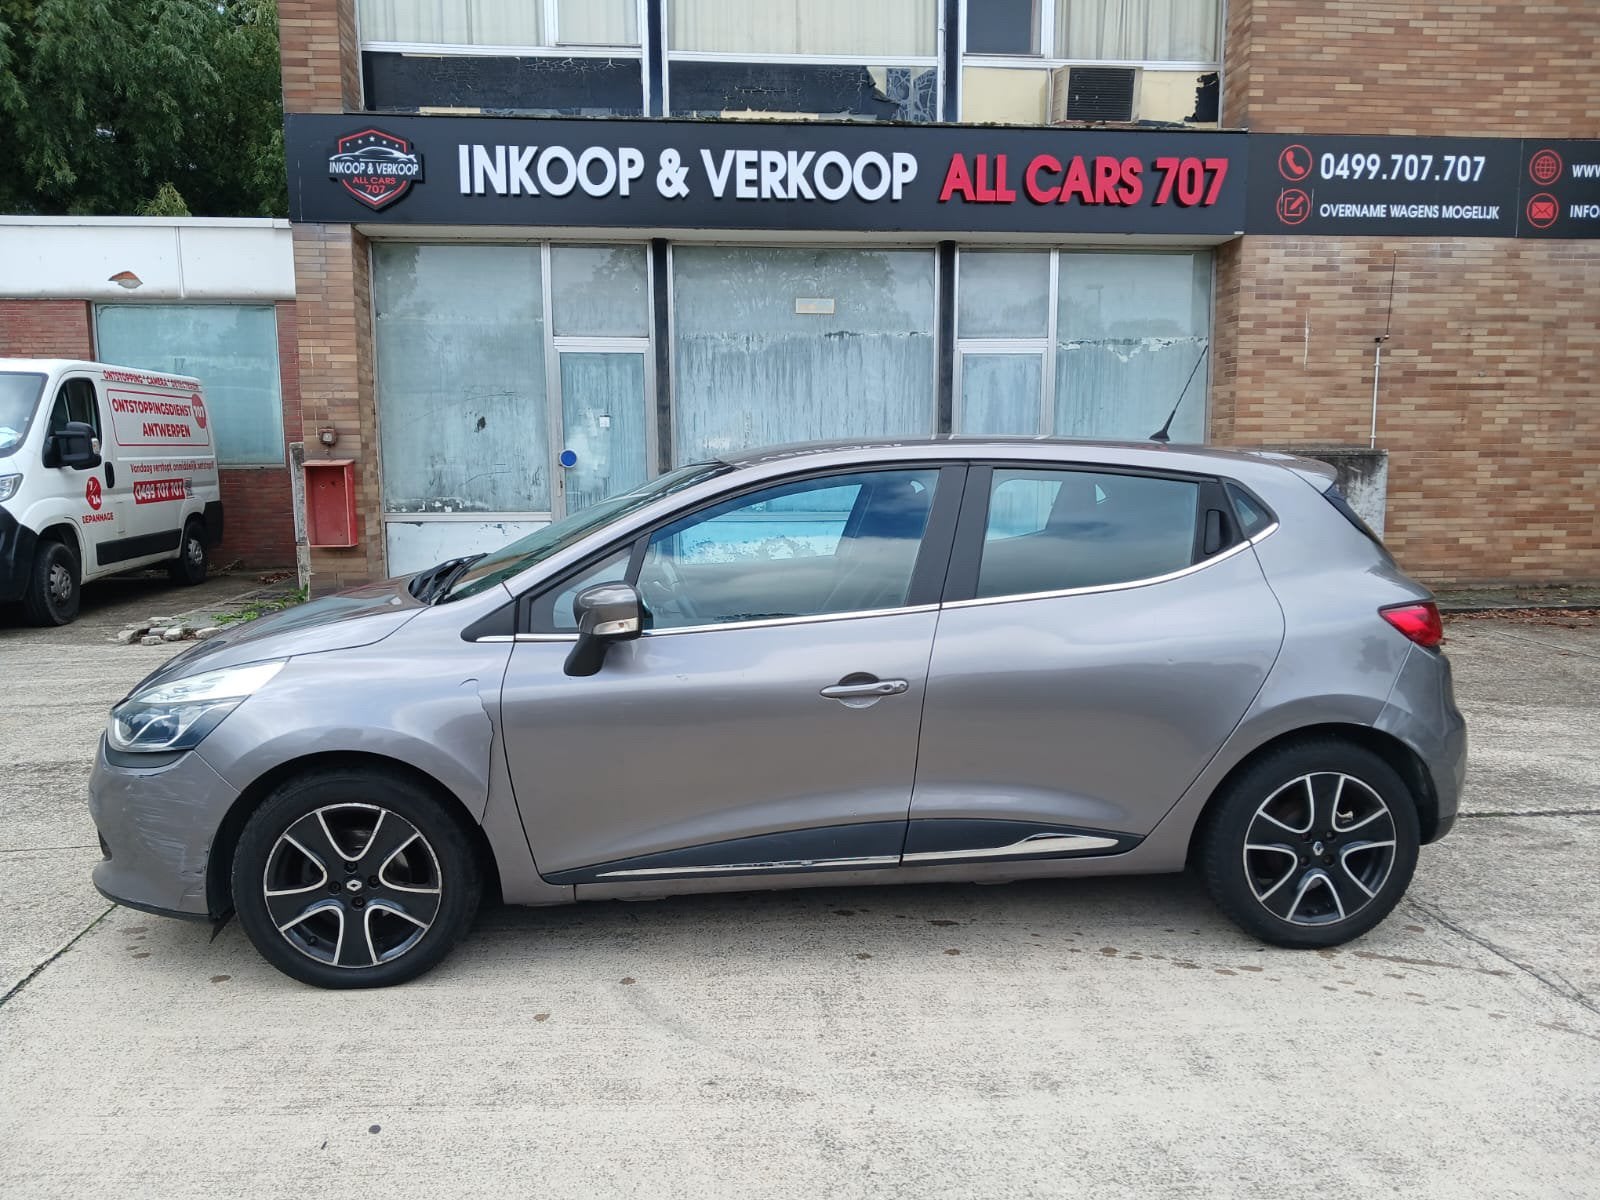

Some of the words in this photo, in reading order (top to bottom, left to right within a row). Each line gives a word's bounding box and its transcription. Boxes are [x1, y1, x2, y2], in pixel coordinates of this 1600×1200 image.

[329, 161, 366, 174] INKOOP
[367, 163, 374, 174] &
[376, 163, 419, 175] VERKOOP
[458, 144, 645, 197] INKOOP
[656, 148, 690, 198] &
[700, 149, 918, 201] VERKOOP
[938, 153, 1016, 203] ALL
[1025, 154, 1144, 206] CARS
[1153, 157, 1229, 206] 707
[1320, 153, 1486, 181] 0499.707.707
[352, 176, 369, 184] ALL
[370, 177, 397, 185] CARS
[365, 185, 386, 193] 707
[1320, 203, 1388, 218] OVERNAME
[1389, 204, 1439, 219] WAGENS
[1441, 205, 1500, 220] MOGELIJK
[111, 398, 192, 416] ONTSTOPPINGSDIENST
[142, 422, 191, 437] ANTWERPEN
[130, 463, 152, 474] Vandaag
[135, 484, 155, 500] 0499
[156, 482, 169, 498] 707
[170, 481, 183, 496] 707
